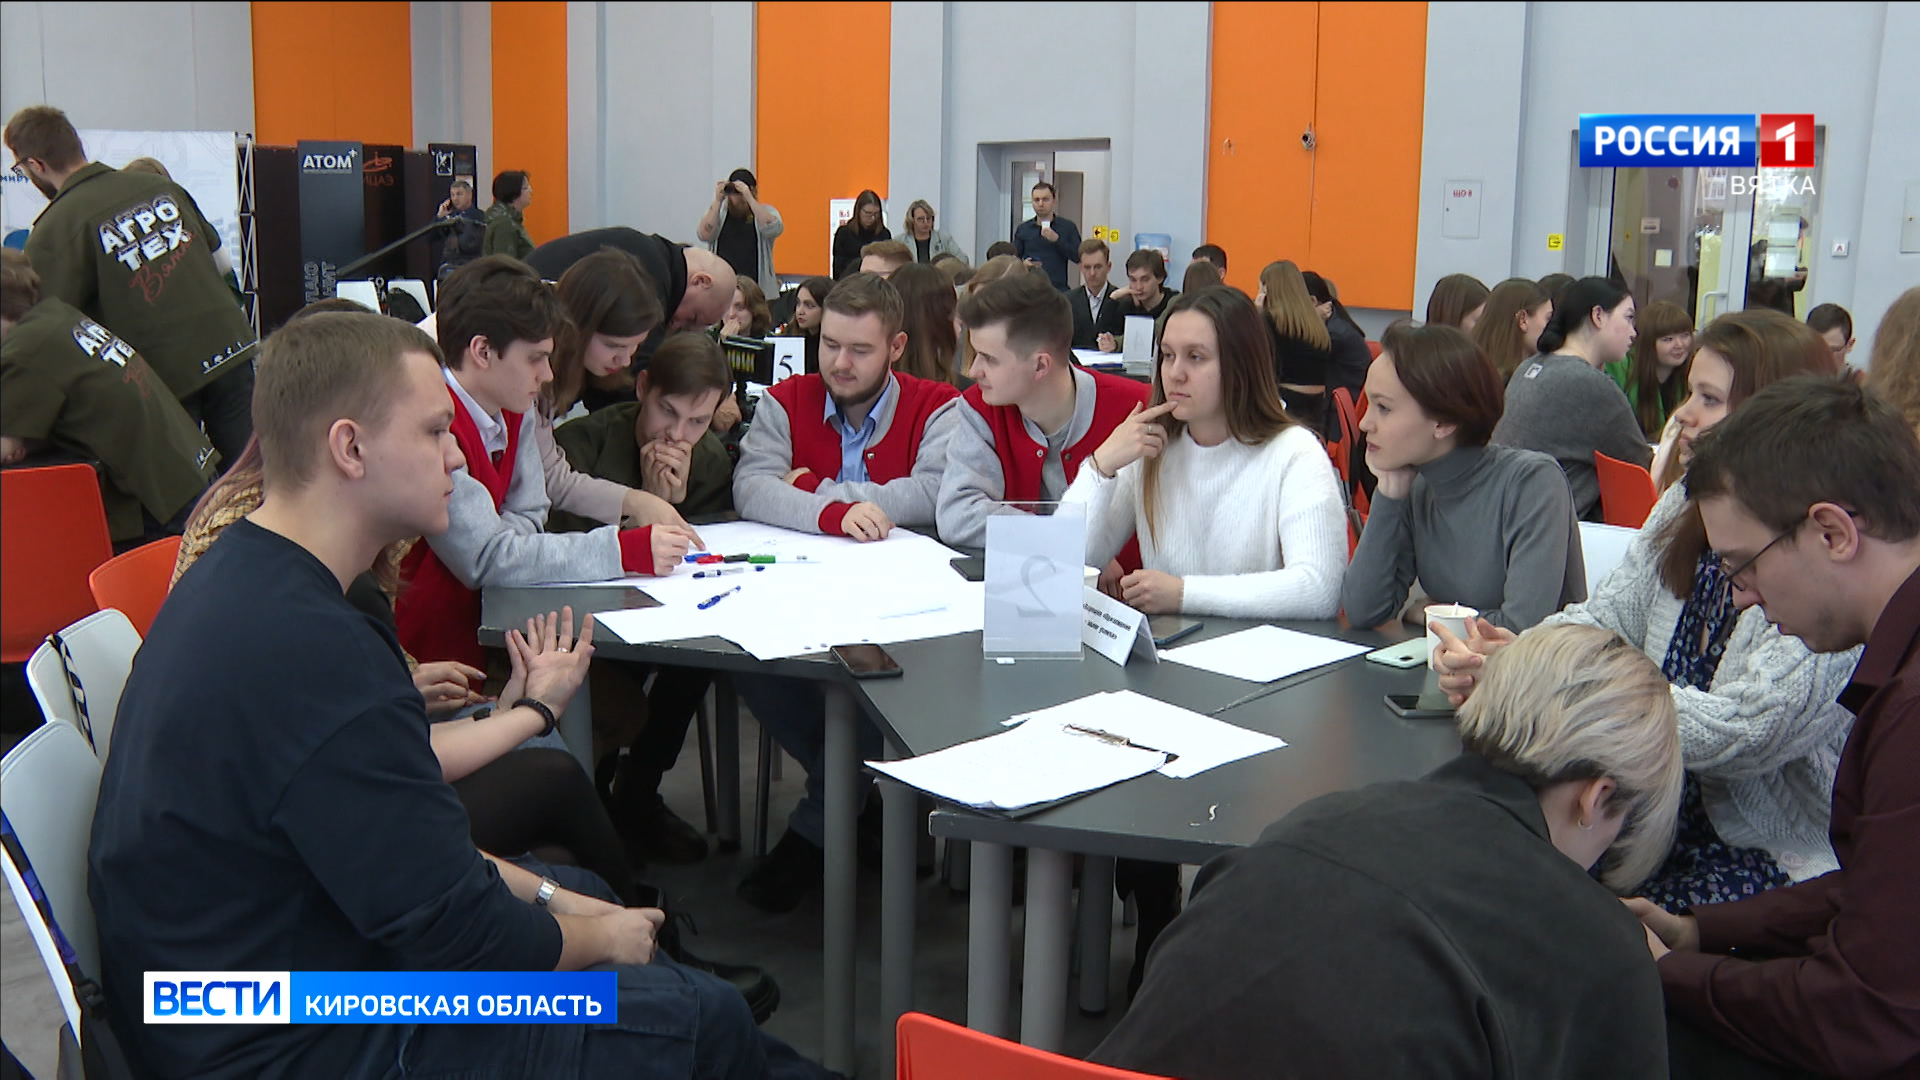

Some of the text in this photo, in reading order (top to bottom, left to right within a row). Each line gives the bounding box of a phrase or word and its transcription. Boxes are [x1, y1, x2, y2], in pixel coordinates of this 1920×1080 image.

[98, 195, 181, 255] АГРО
[116, 220, 192, 272] ТЕХ
[777, 354, 793, 382] 5
